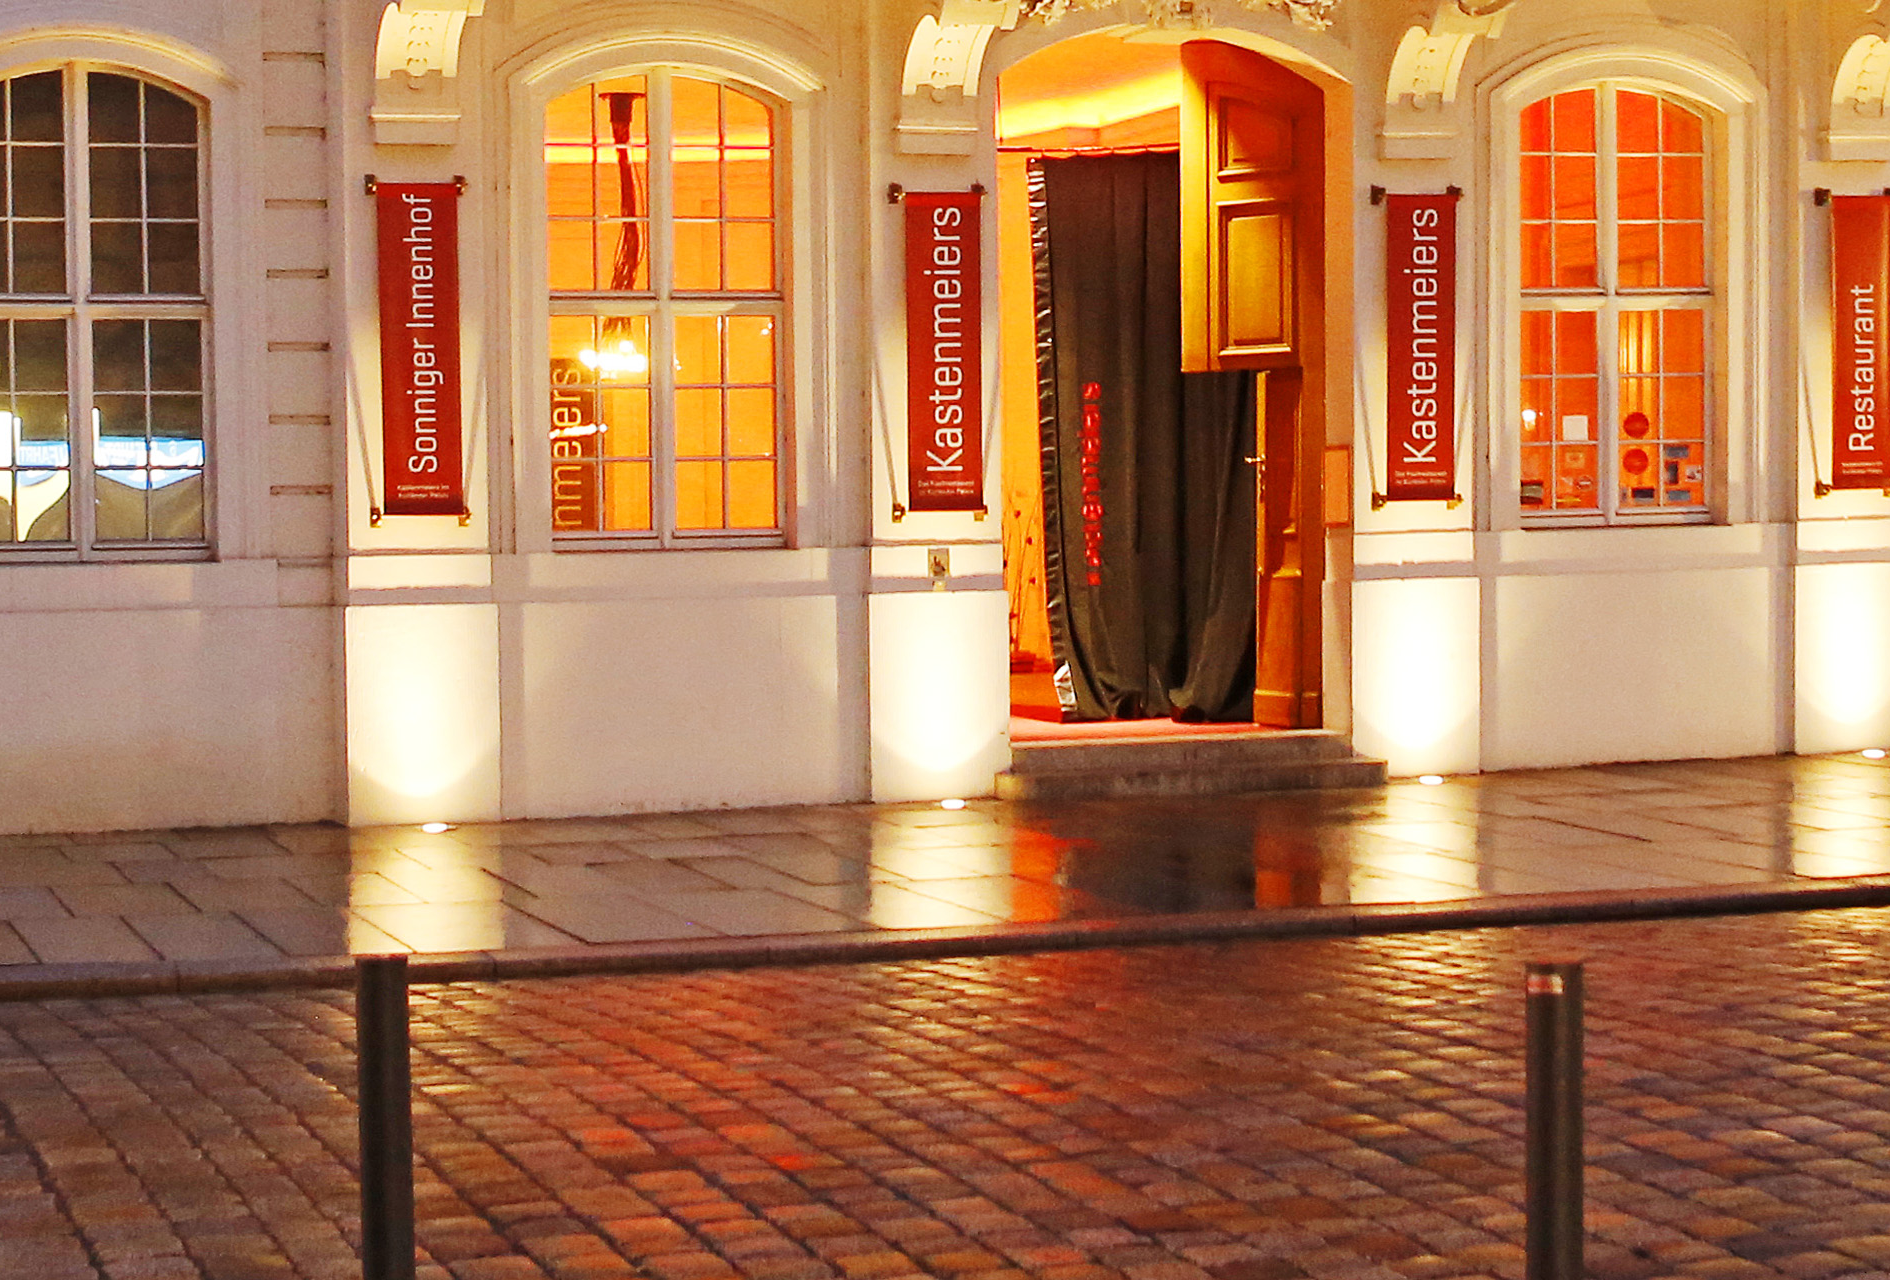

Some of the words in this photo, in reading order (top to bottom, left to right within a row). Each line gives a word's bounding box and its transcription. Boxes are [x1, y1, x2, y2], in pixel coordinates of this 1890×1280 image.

[402, 193, 434, 327] Innenhof
[923, 207, 963, 472] Kastenmeiers
[1403, 208, 1438, 463] Kastenmeiers
[406, 337, 444, 473] Sonniger
[1848, 283, 1875, 452] Restaurant
